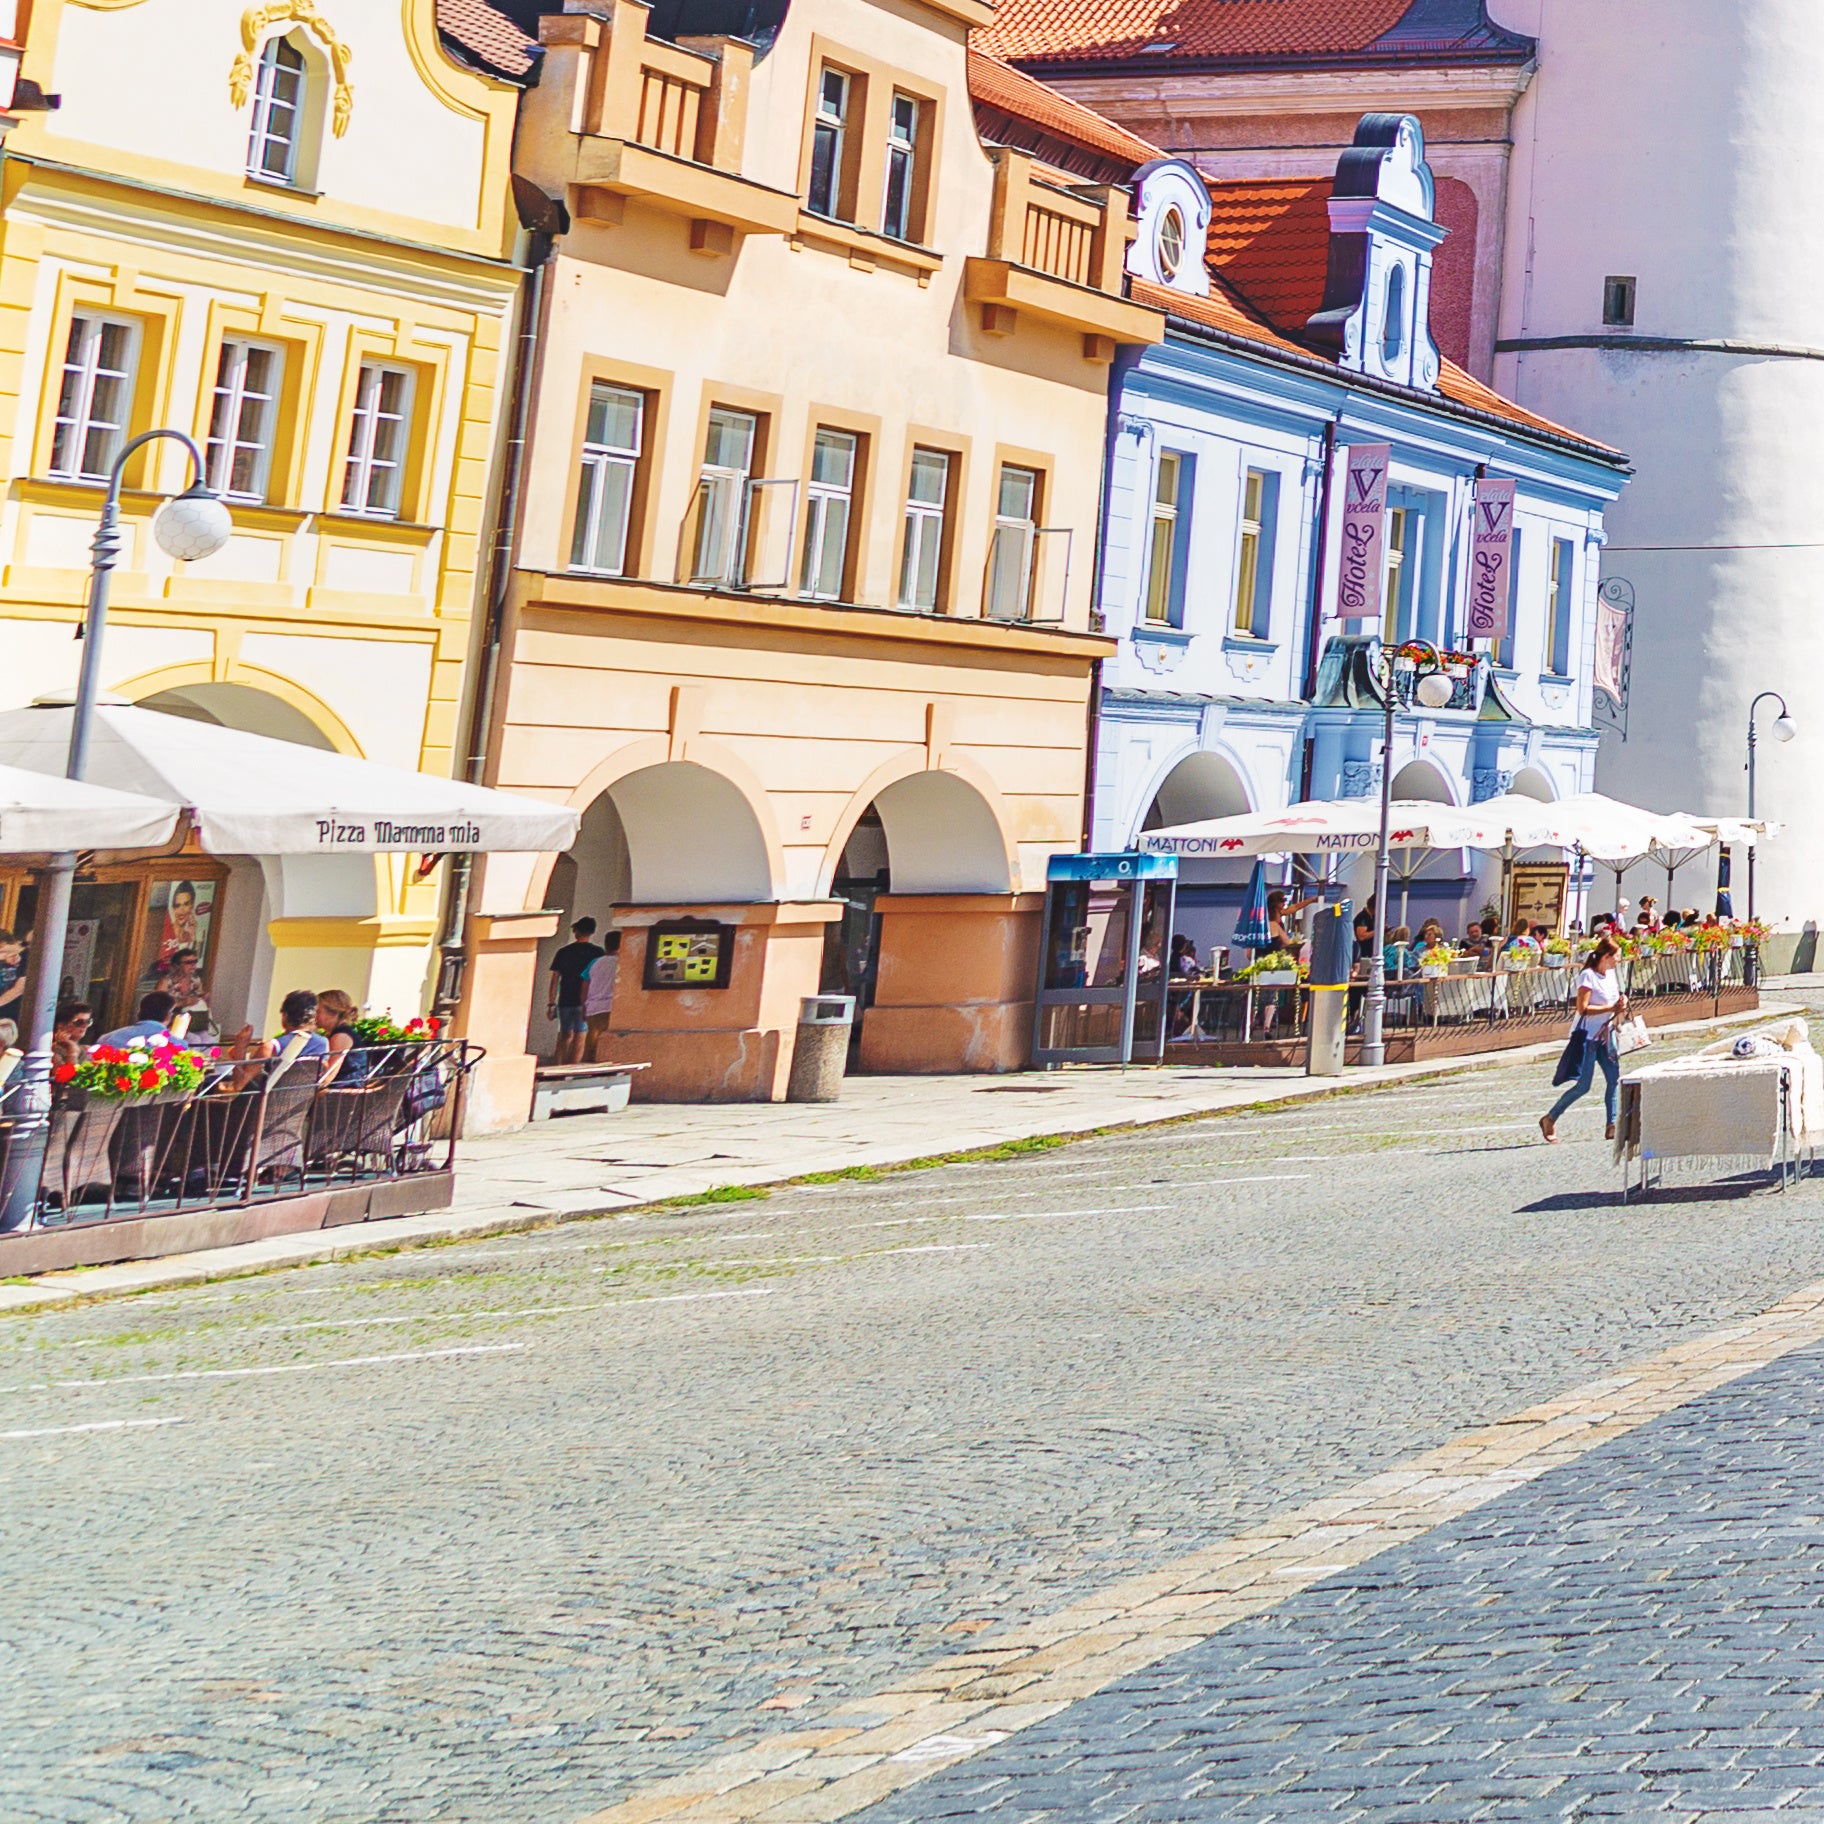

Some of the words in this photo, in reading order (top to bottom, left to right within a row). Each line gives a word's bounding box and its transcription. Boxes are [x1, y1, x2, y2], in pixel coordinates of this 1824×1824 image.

[316, 819, 365, 844] Pizza
[375, 822, 445, 844] Mamma
[450, 822, 481, 843] mia
[1147, 837, 1218, 853] MATTONI
[1316, 832, 1382, 849] MATTON
